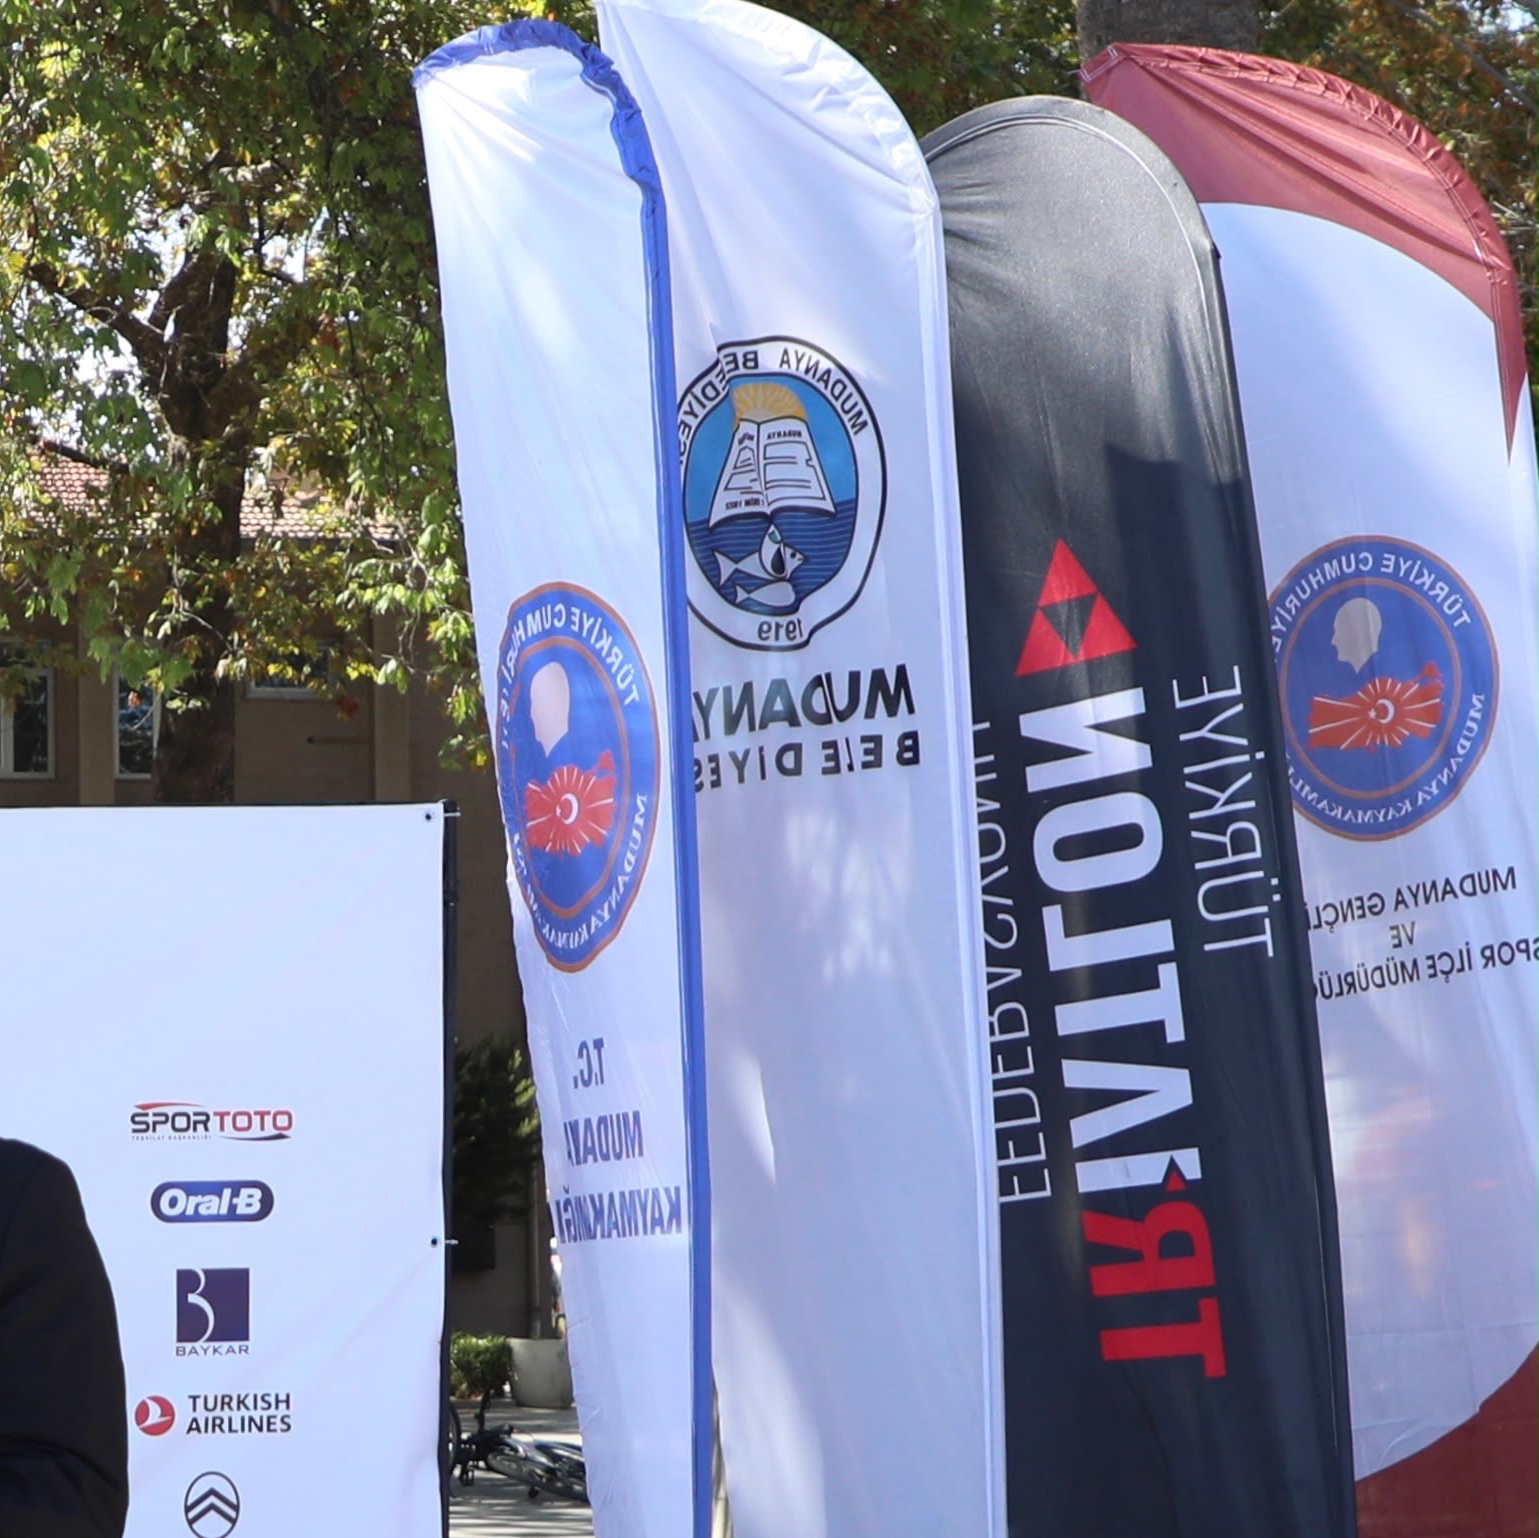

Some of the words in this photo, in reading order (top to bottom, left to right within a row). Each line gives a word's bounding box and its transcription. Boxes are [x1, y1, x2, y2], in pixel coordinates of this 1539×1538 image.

[159, 1187, 261, 1216] Oral-B
[176, 1345, 250, 1356] BAYKAR
[188, 1394, 291, 1412] TURKISH
[186, 1414, 292, 1434] AIRLINES
